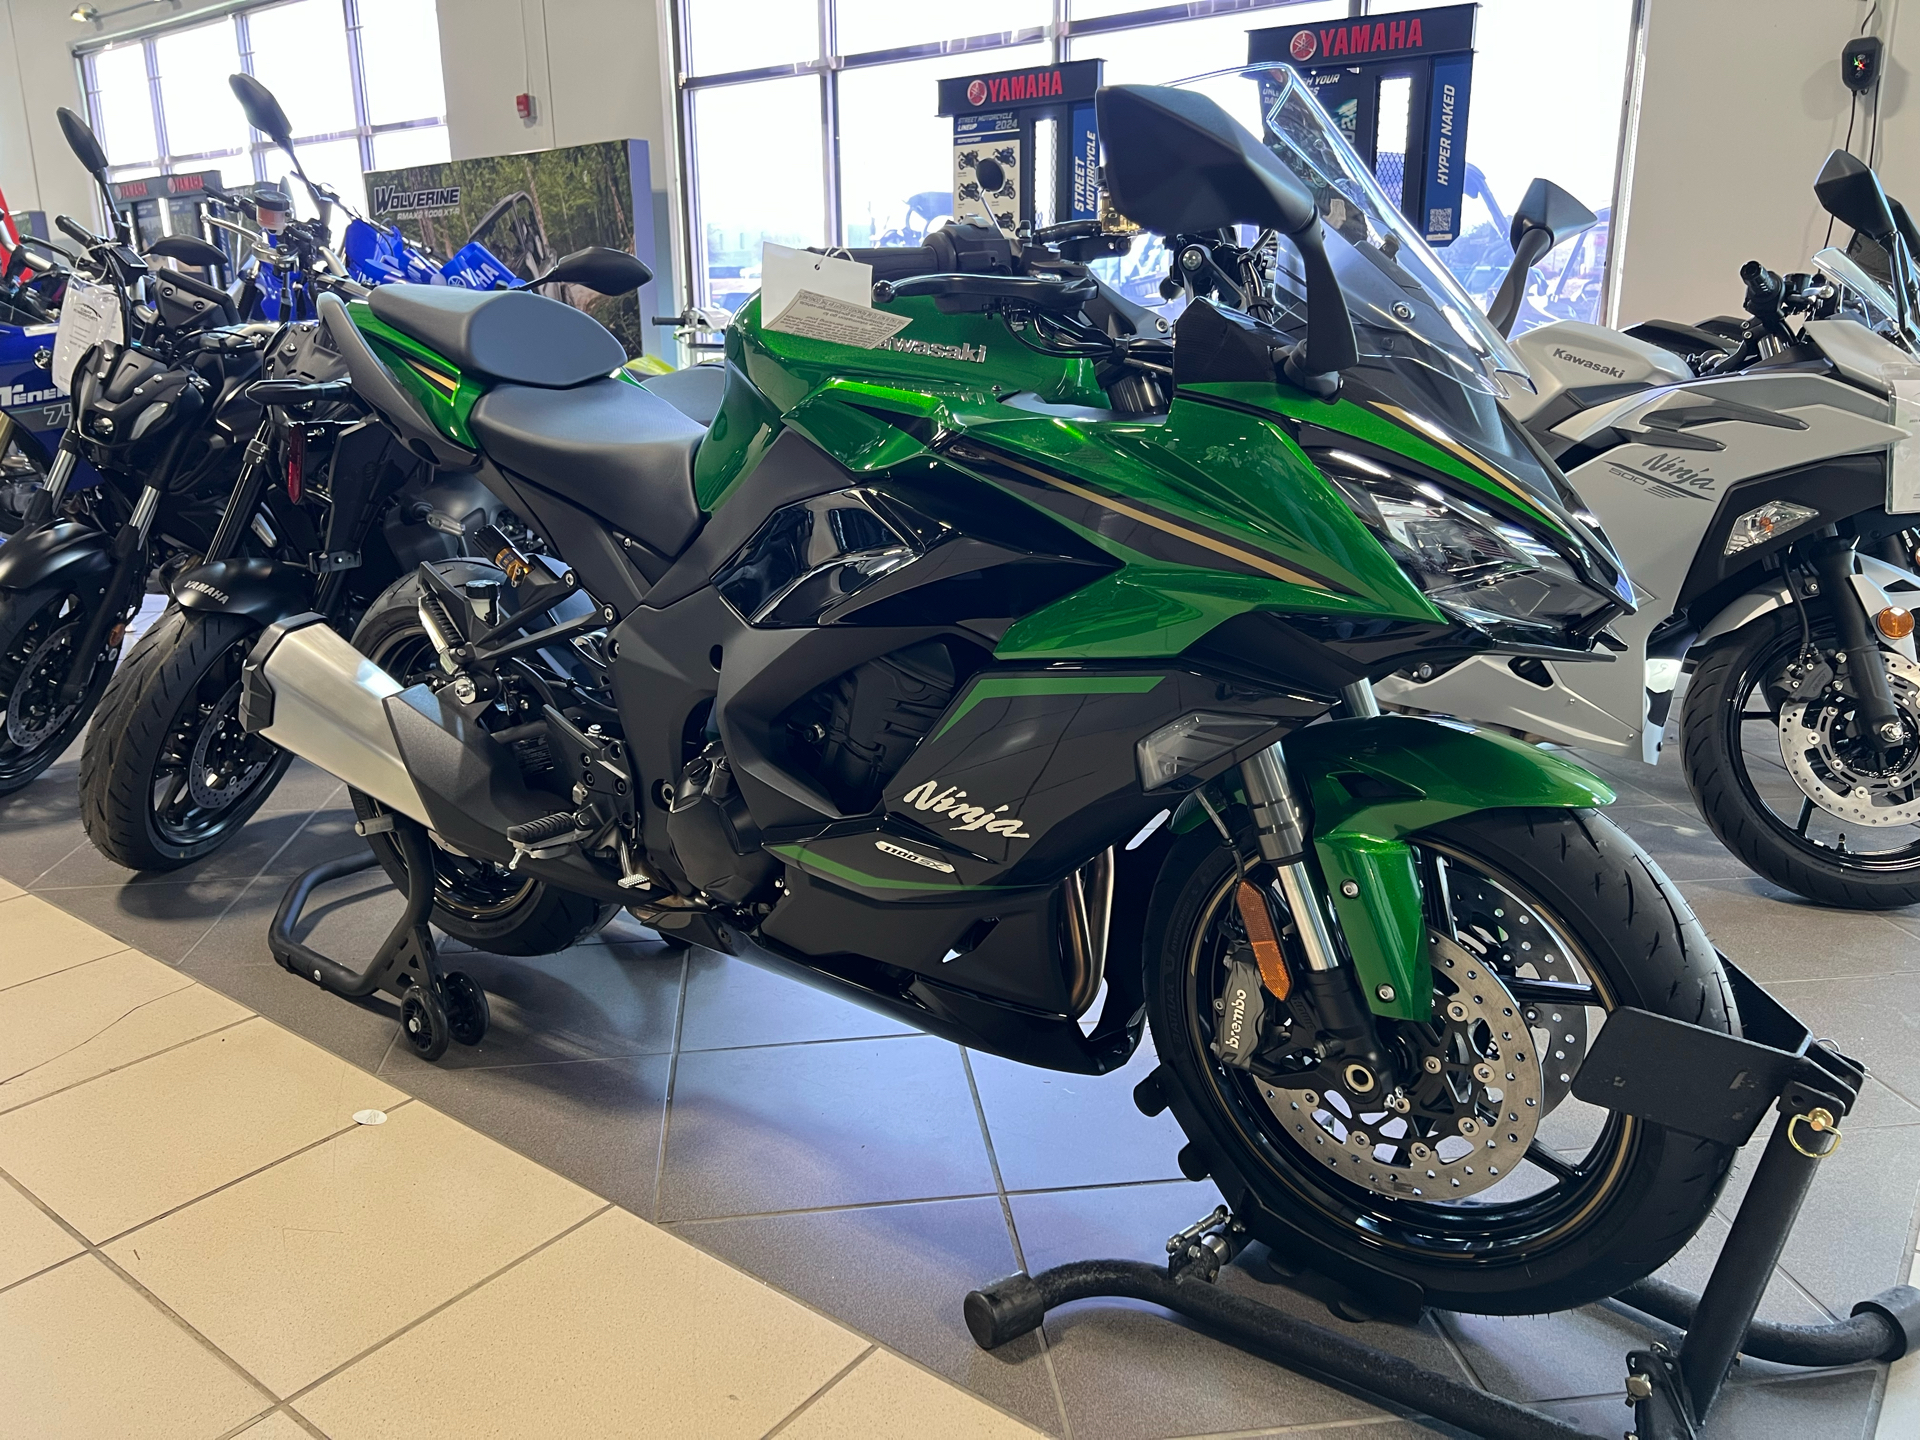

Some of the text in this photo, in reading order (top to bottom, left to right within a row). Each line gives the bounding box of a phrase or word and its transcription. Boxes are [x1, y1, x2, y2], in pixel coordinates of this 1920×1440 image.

[1319, 18, 1423, 57] YAMAHA
[988, 70, 1063, 103] YAMAHA
[1315, 73, 1340, 85] YOUR
[957, 115, 977, 124] STREET
[957, 119, 1017, 132] LINEUP 2024
[1436, 84, 1456, 186] HYPER NAKED
[175, 174, 205, 192] YAMAHA
[1074, 156, 1085, 212] STREET
[1085, 130, 1096, 212] MOTORCYCLE
[374, 185, 460, 216] WOLVERINE
[876, 337, 987, 363] awasaki
[1552, 347, 1626, 379] Kawasaki
[1608, 467, 1647, 486] 500
[1642, 453, 1716, 491] Ninja
[184, 580, 229, 605] YAMAHA
[903, 780, 1030, 838] Ninja
[1225, 988, 1247, 1049] brembo
